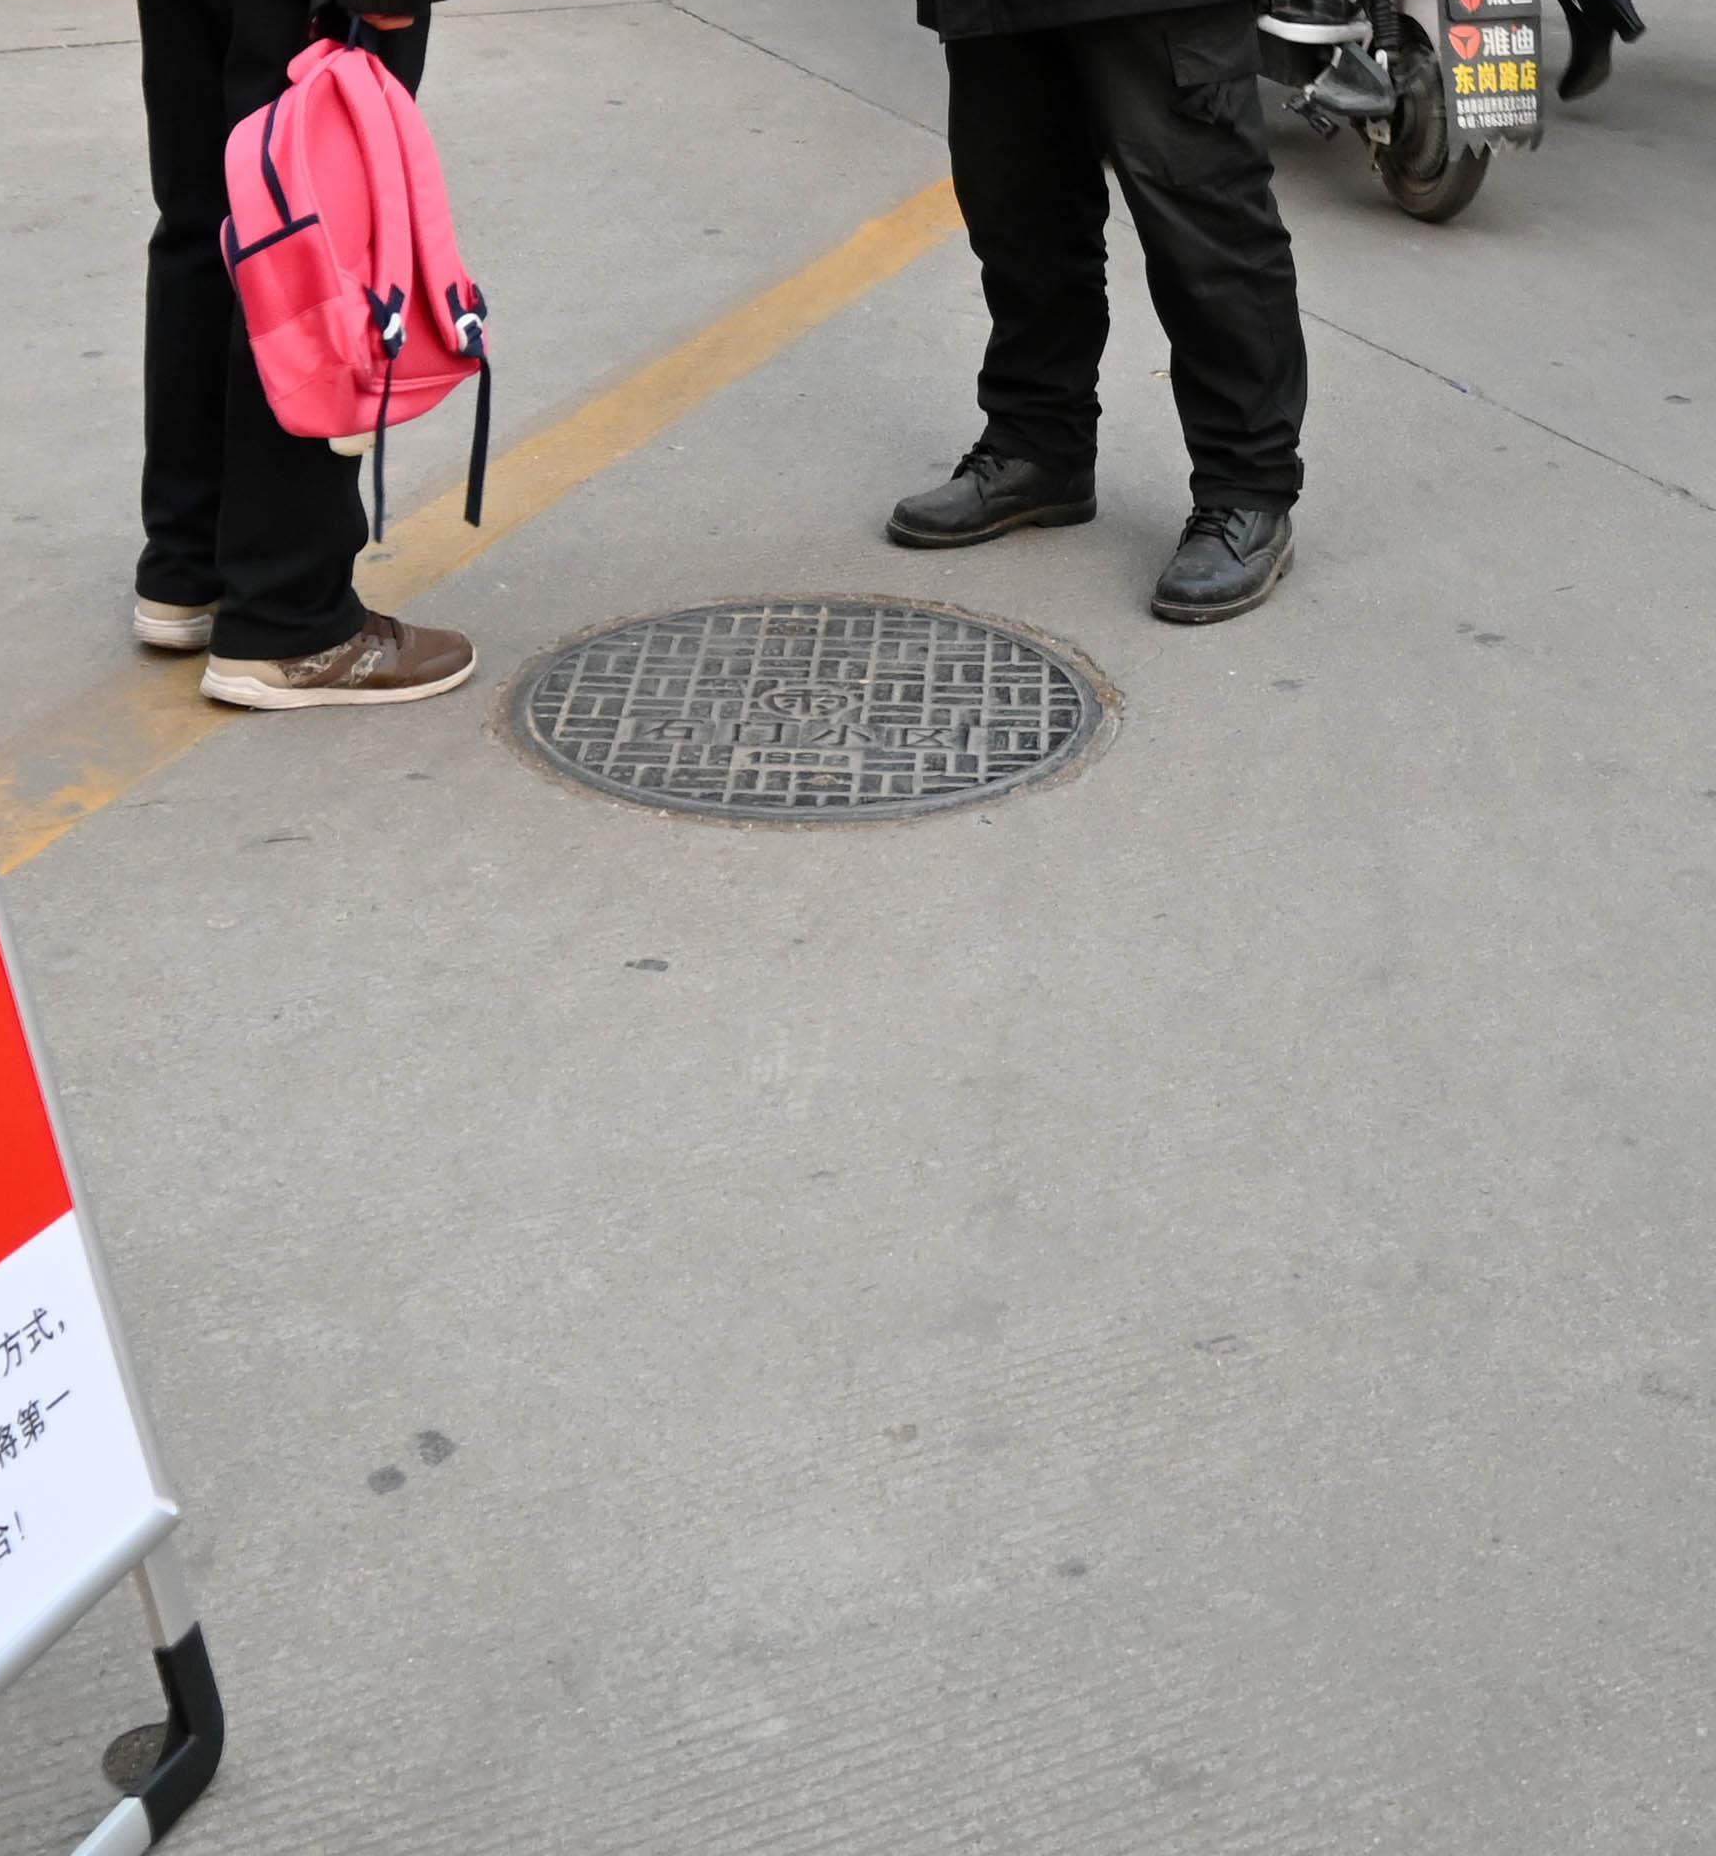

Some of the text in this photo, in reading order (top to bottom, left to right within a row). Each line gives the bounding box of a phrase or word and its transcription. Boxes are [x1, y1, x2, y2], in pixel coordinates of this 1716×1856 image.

[1481, 24, 1536, 57] 雅迪
[1452, 60, 1539, 95] 东岗路店
[641, 719, 956, 748] 石门小区
